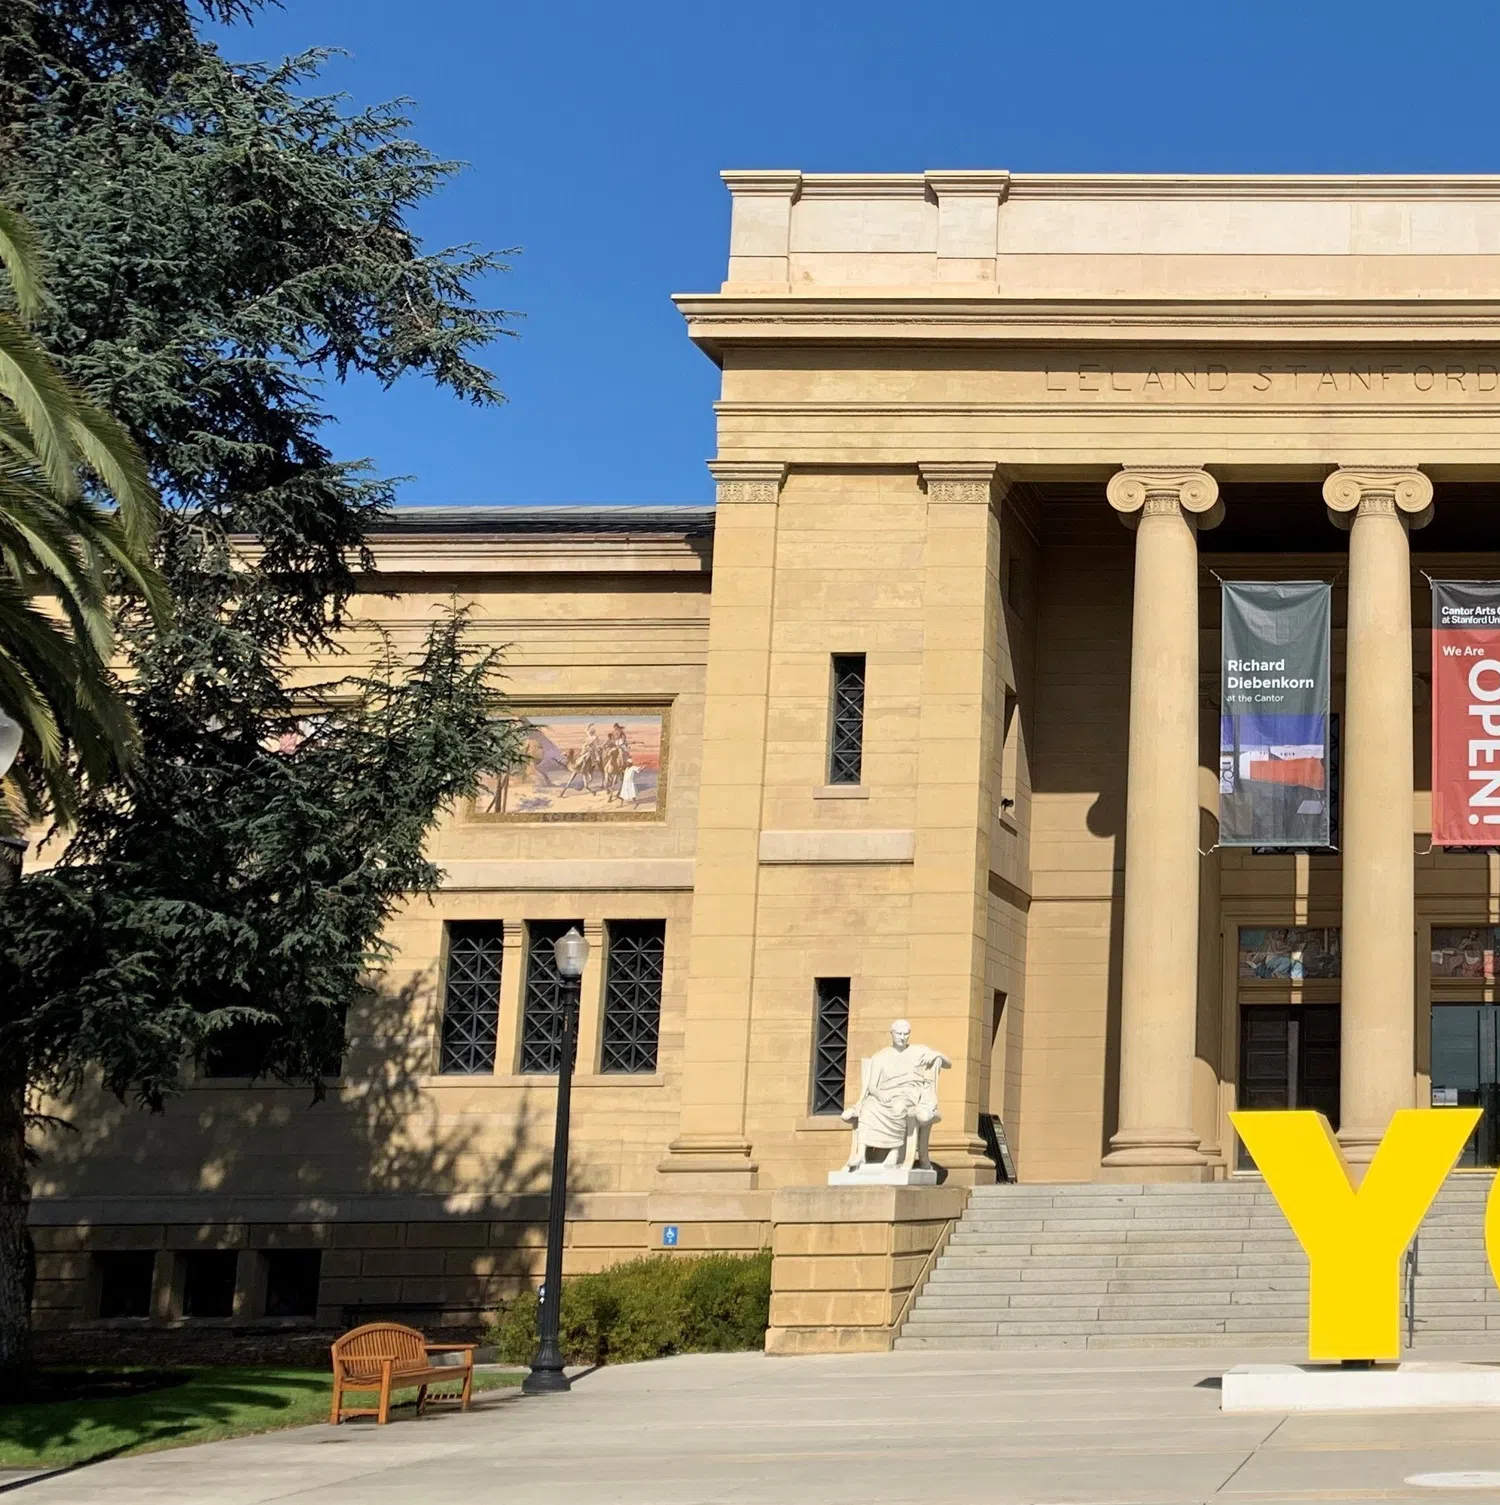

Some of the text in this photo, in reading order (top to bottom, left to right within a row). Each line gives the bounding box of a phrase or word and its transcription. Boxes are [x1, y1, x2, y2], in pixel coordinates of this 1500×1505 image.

[1045, 363, 1229, 392] LELAND
[1252, 364, 1499, 392] STANFORD
[1441, 606, 1474, 615] Cantor
[1474, 606, 1496, 615] Arts
[1441, 616, 1451, 624] at
[1451, 615, 1487, 624] Stanford
[1442, 646, 1485, 656] We Are
[1227, 659, 1285, 671] Richard
[1227, 677, 1314, 689] Diebenkorn
[1226, 694, 1285, 702] at the Cantor
